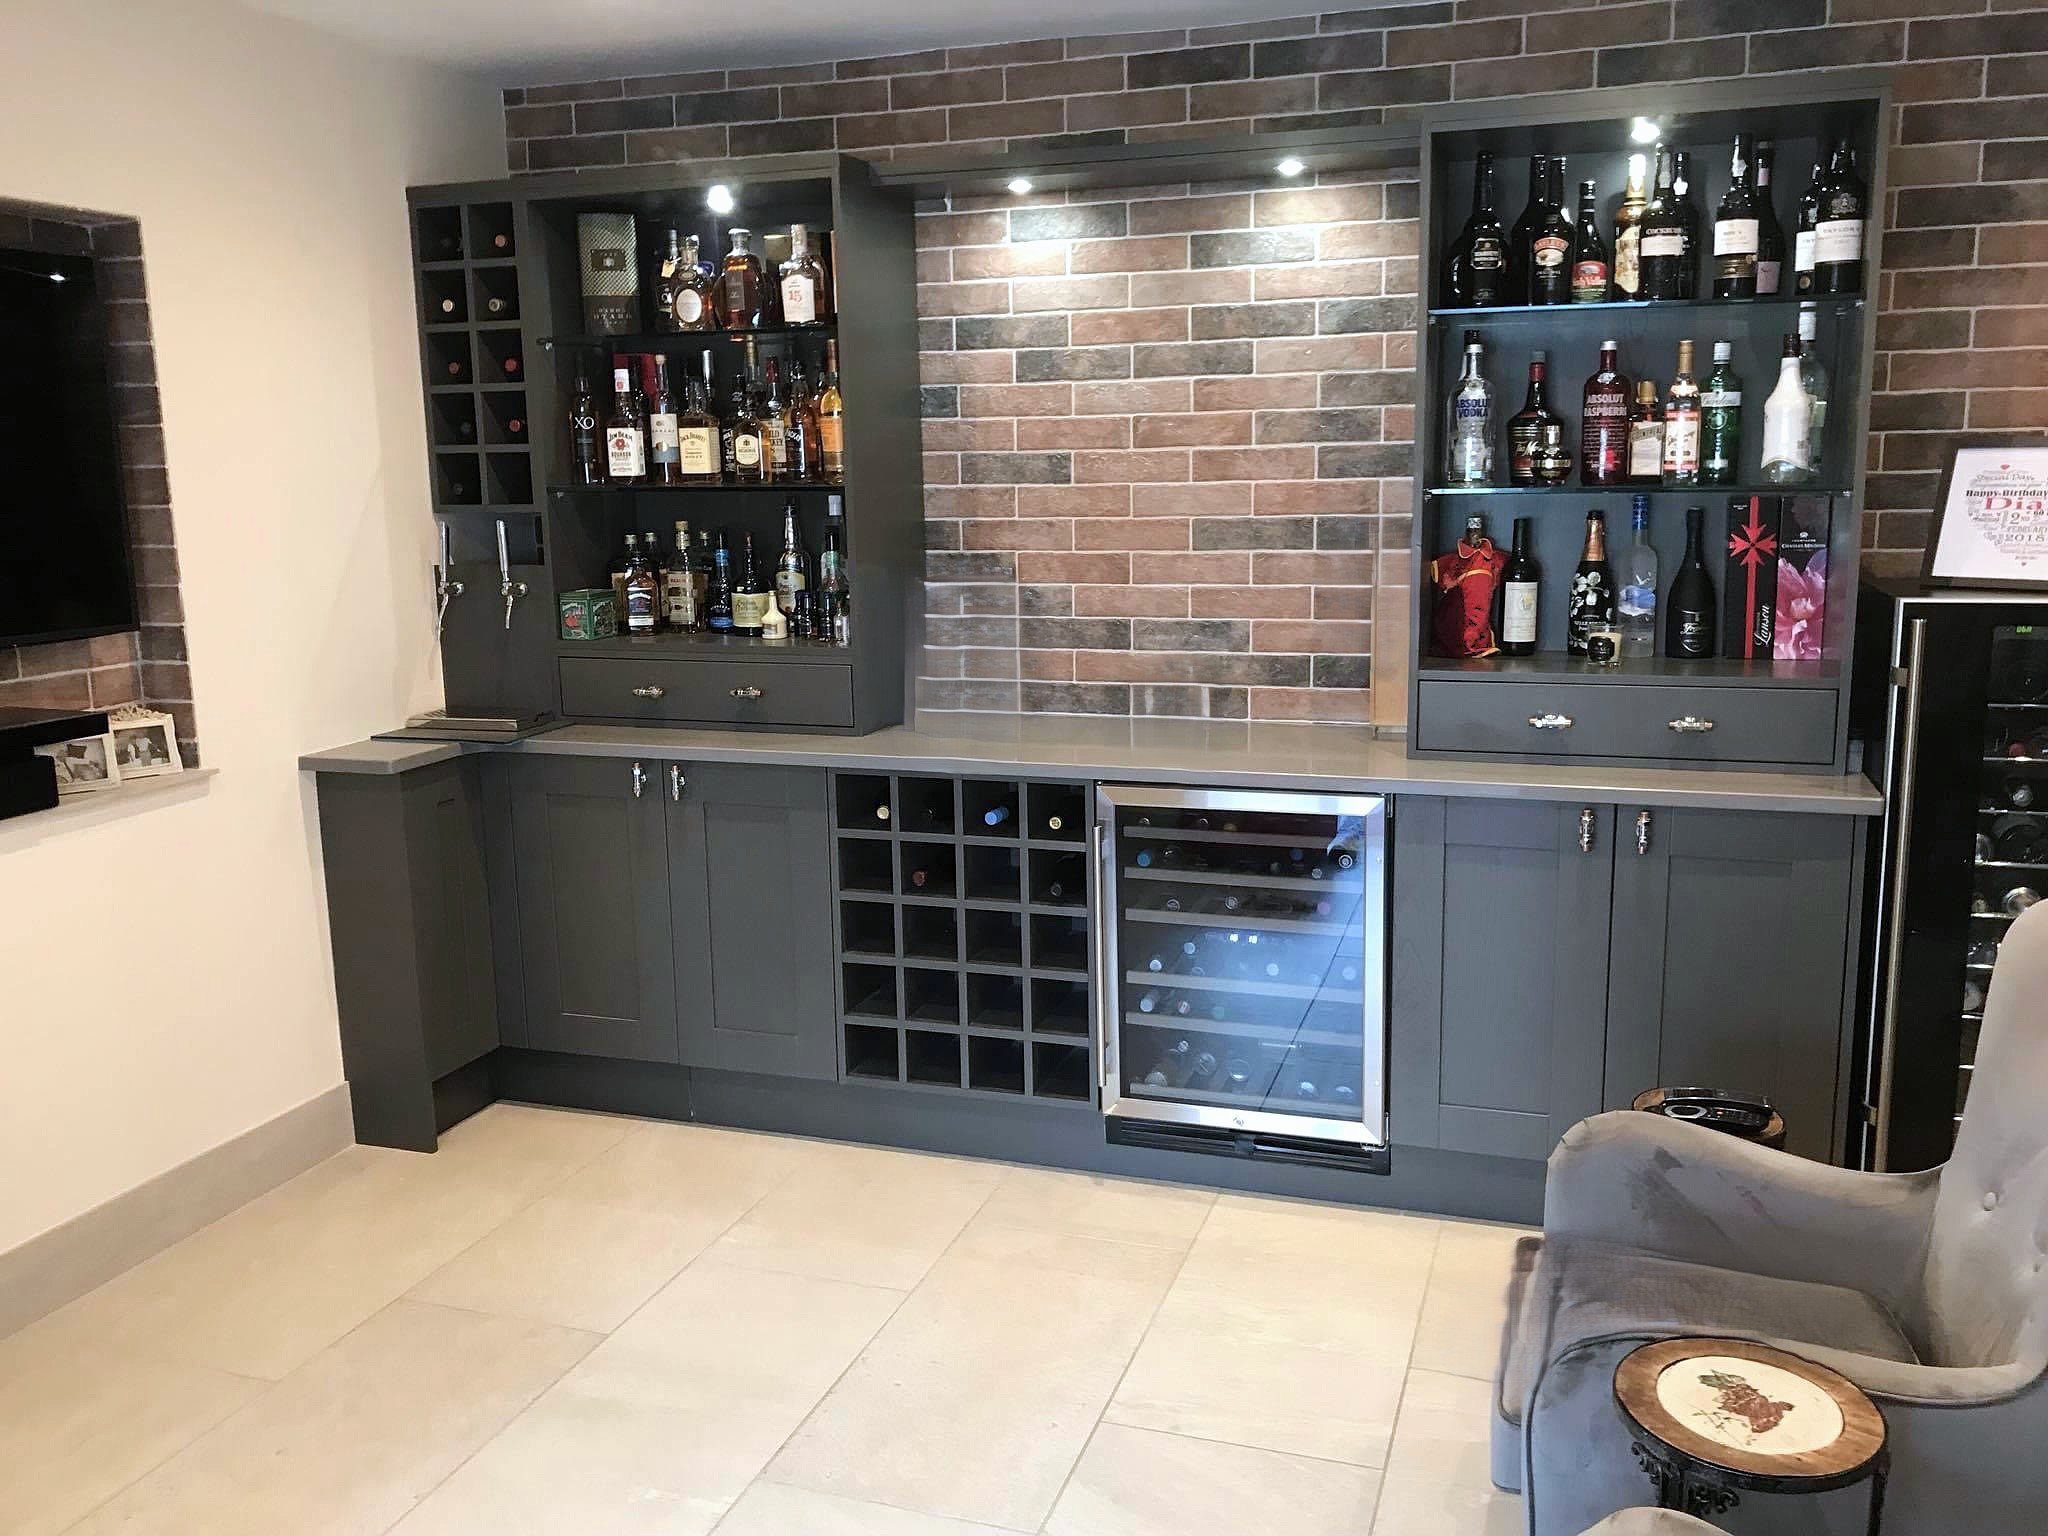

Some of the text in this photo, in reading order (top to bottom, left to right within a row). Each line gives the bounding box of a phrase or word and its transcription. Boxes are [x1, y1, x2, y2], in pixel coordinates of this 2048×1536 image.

[788, 290, 802, 302] 15
[1455, 398, 1489, 408] ABSOLU
[1587, 393, 1624, 404] ABSOLUT
[1458, 407, 1488, 419] VODKA
[574, 416, 595, 430] XO
[1754, 604, 1770, 648] Lanson
